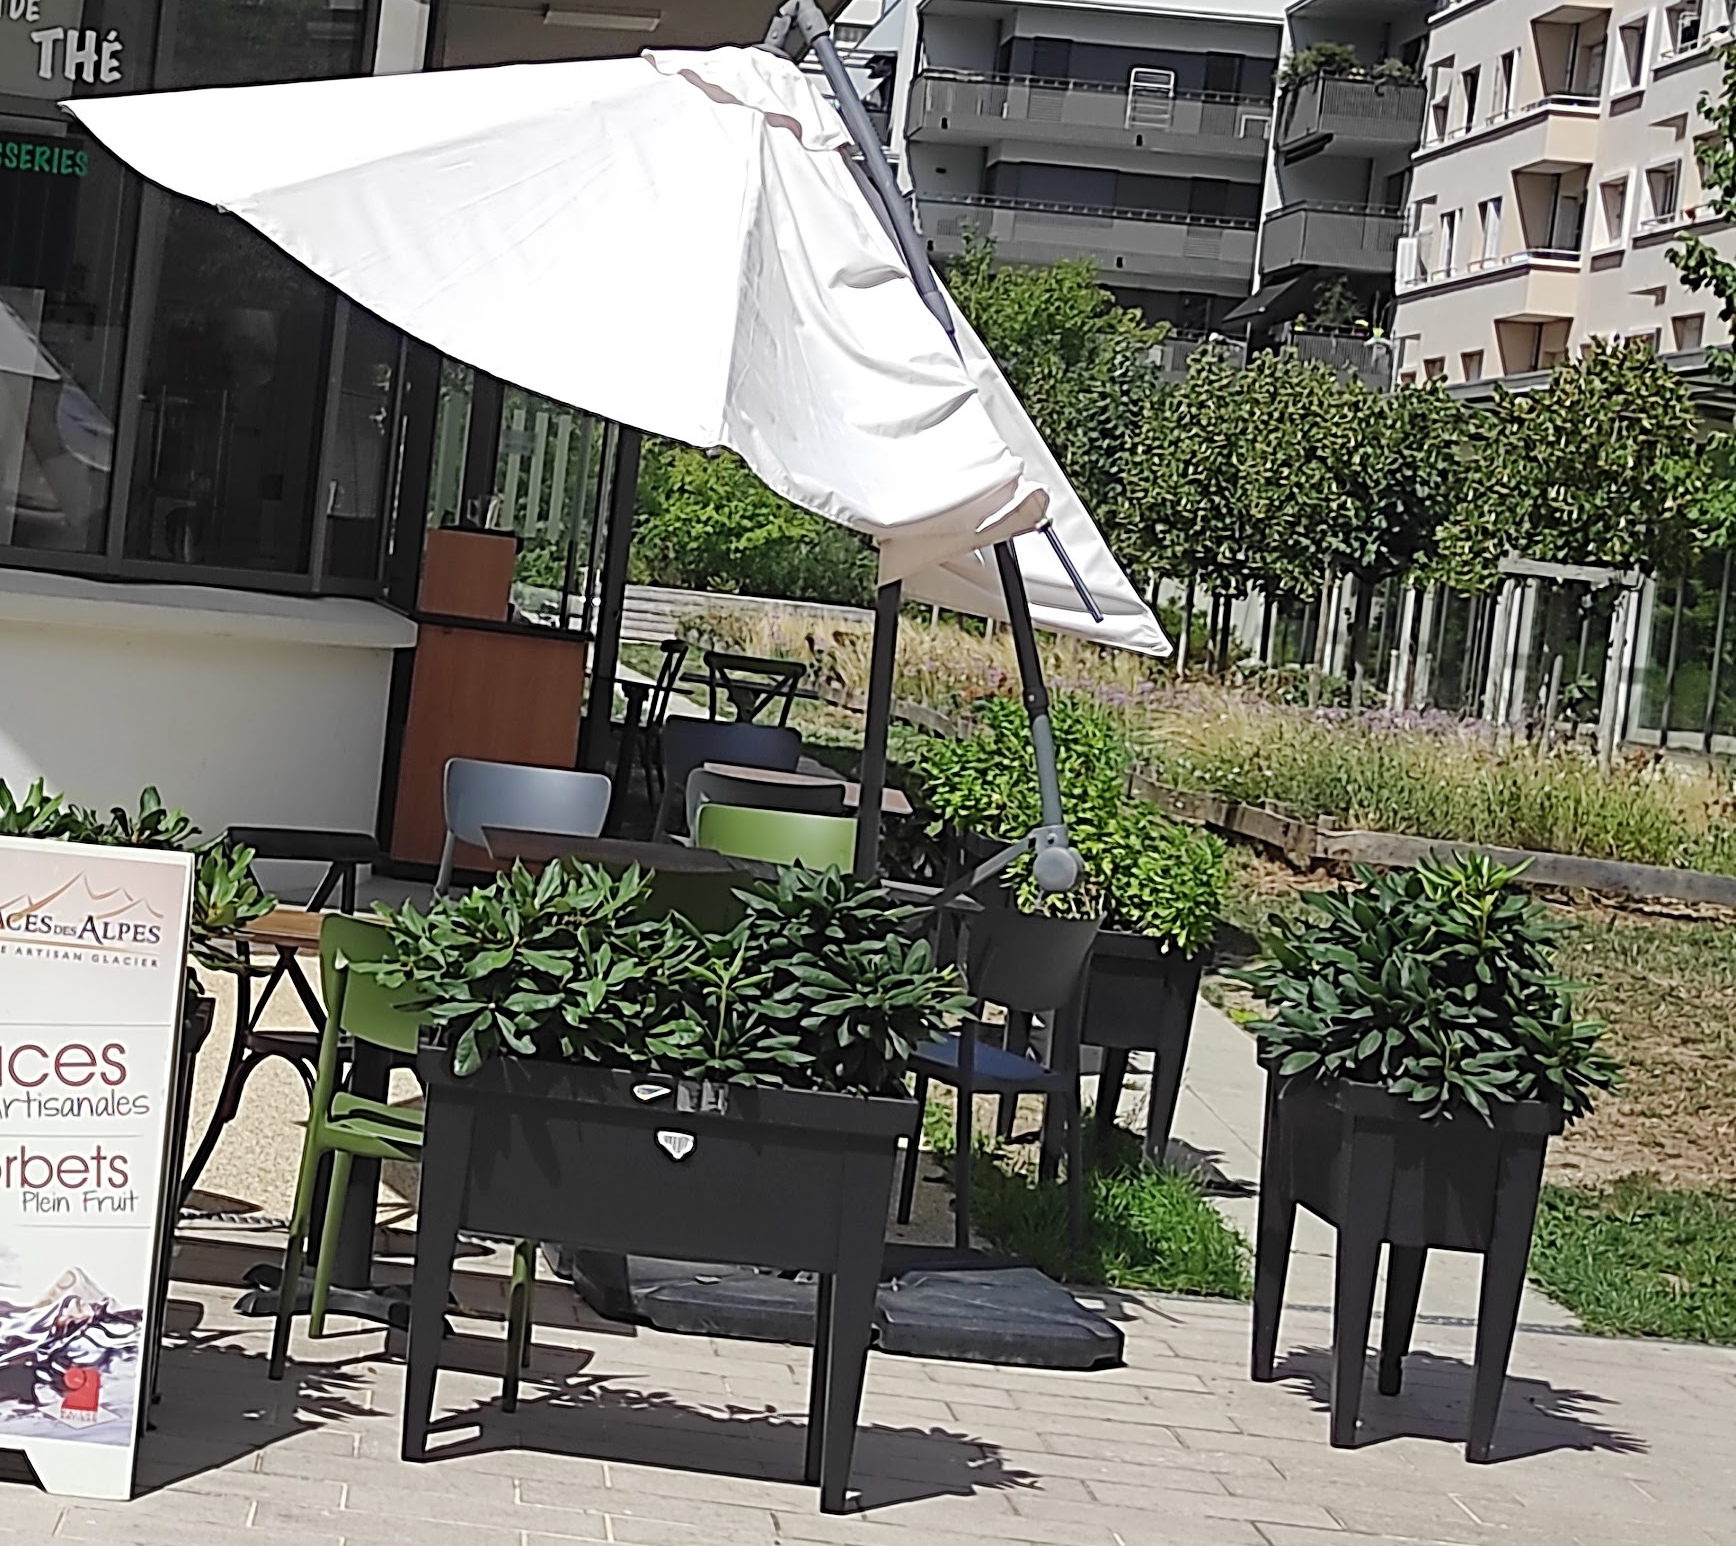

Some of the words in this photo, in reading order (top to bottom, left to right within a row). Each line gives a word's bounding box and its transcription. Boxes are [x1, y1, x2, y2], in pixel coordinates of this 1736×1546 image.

[30, 27, 123, 84] THÉ
[15, 946, 82, 961] ARTISAN
[91, 953, 159, 968] GLACIER
[22, 1190, 70, 1213] Plein
[82, 1190, 139, 1213] Fruit
